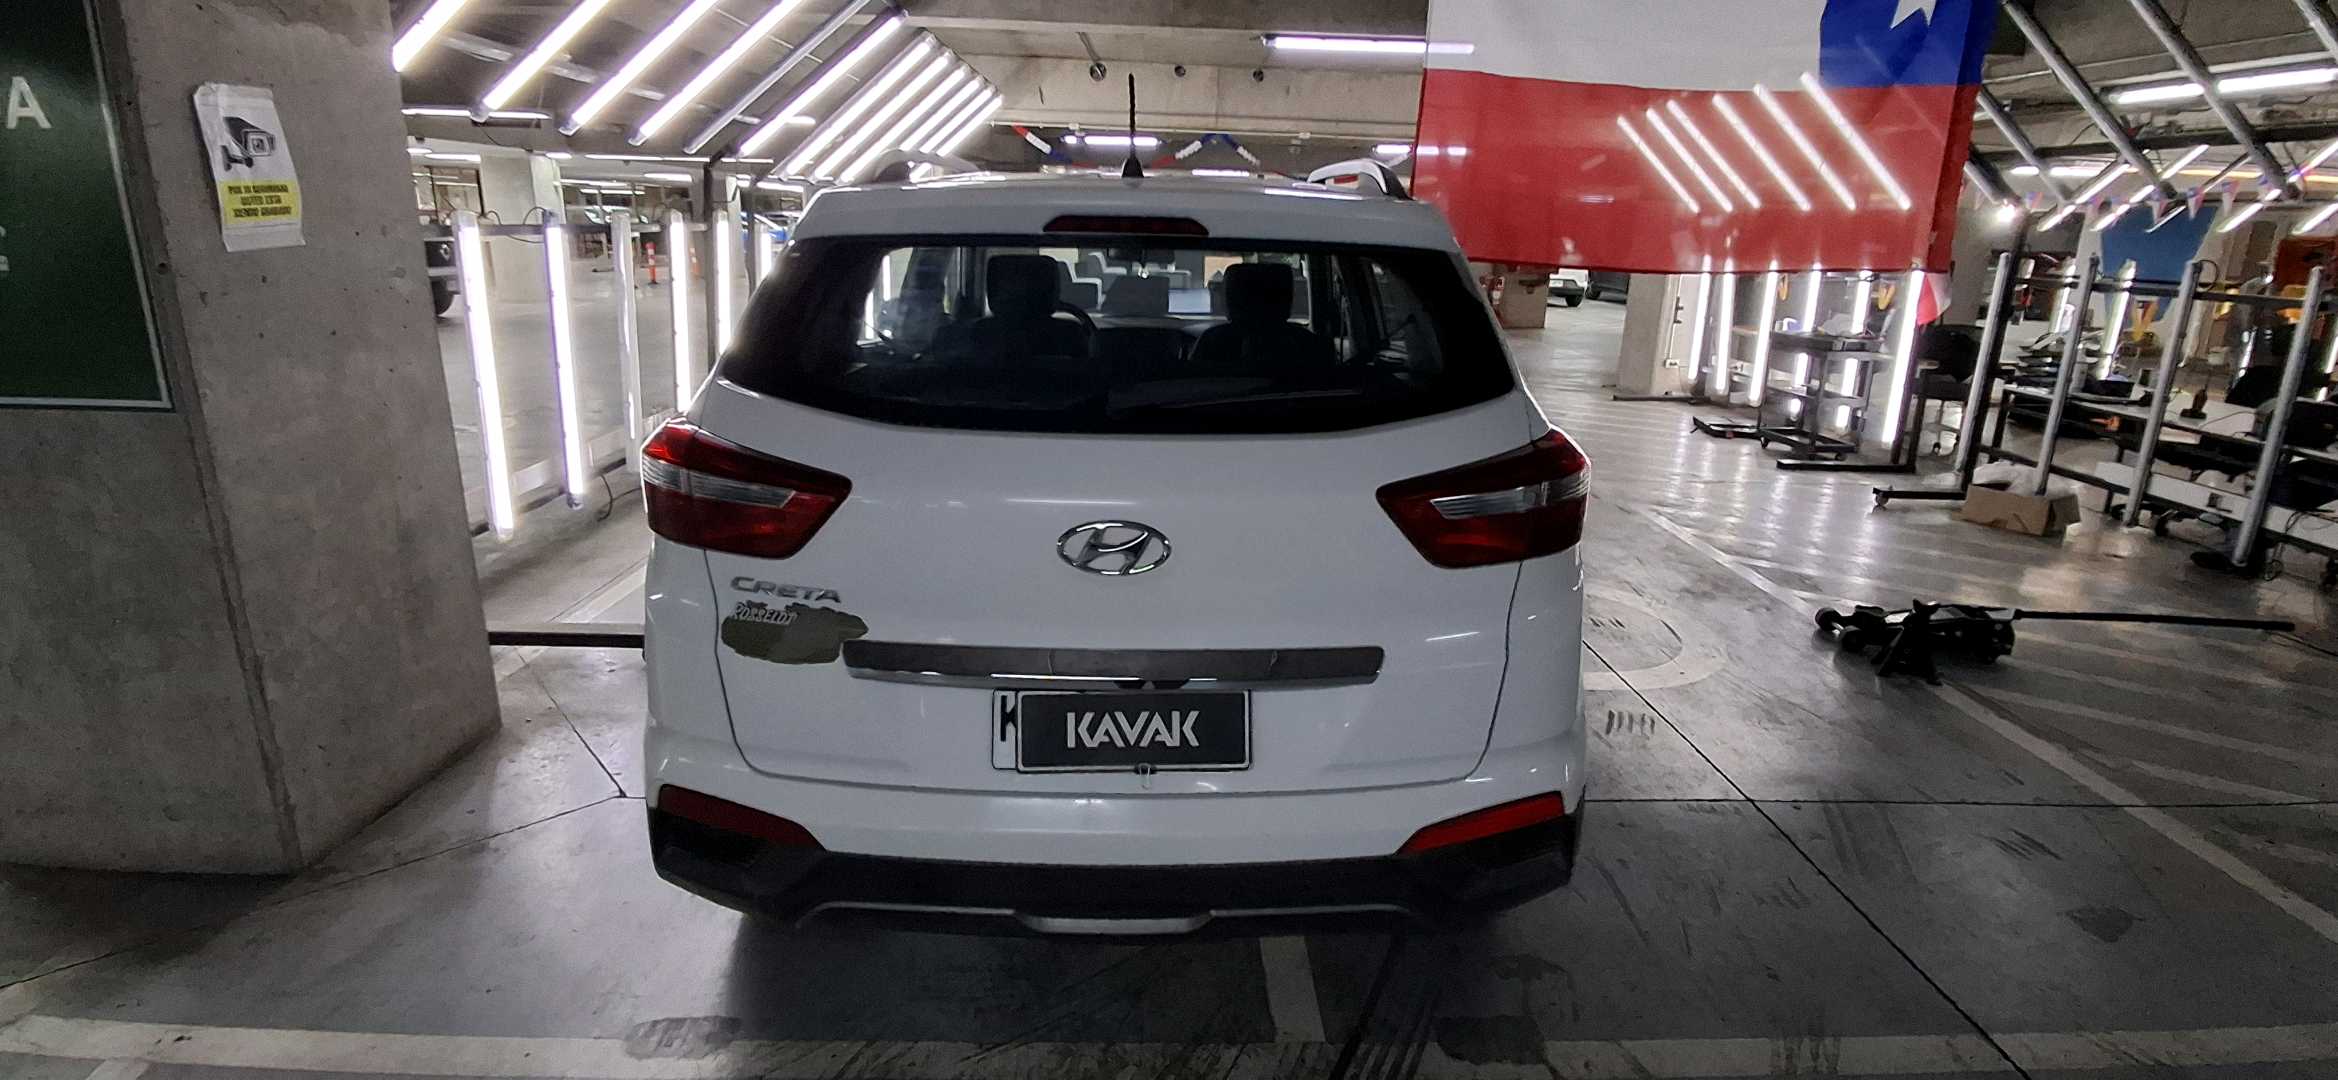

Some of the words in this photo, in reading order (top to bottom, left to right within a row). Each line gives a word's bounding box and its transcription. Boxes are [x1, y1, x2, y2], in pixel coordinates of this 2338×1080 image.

[6, 76, 52, 130] A
[730, 576, 841, 603] CRETA
[1066, 710, 1200, 748] KAVAK
